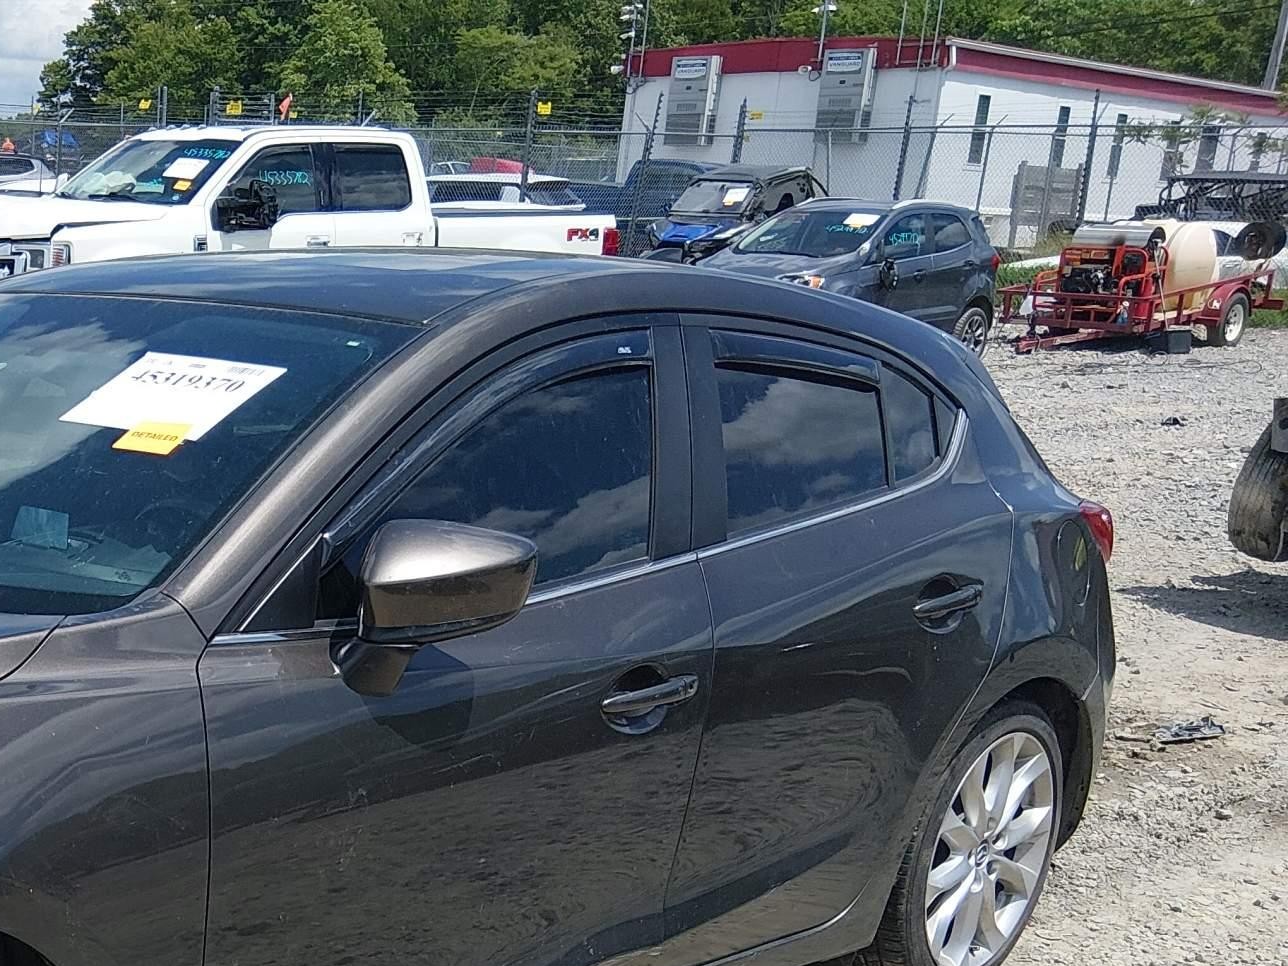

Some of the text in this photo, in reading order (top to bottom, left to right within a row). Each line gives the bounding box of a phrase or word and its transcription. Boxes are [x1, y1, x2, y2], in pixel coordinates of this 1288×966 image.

[567, 228, 599, 241] FX4
[131, 369, 246, 393] 45319370
[129, 430, 179, 443] DETAILED
